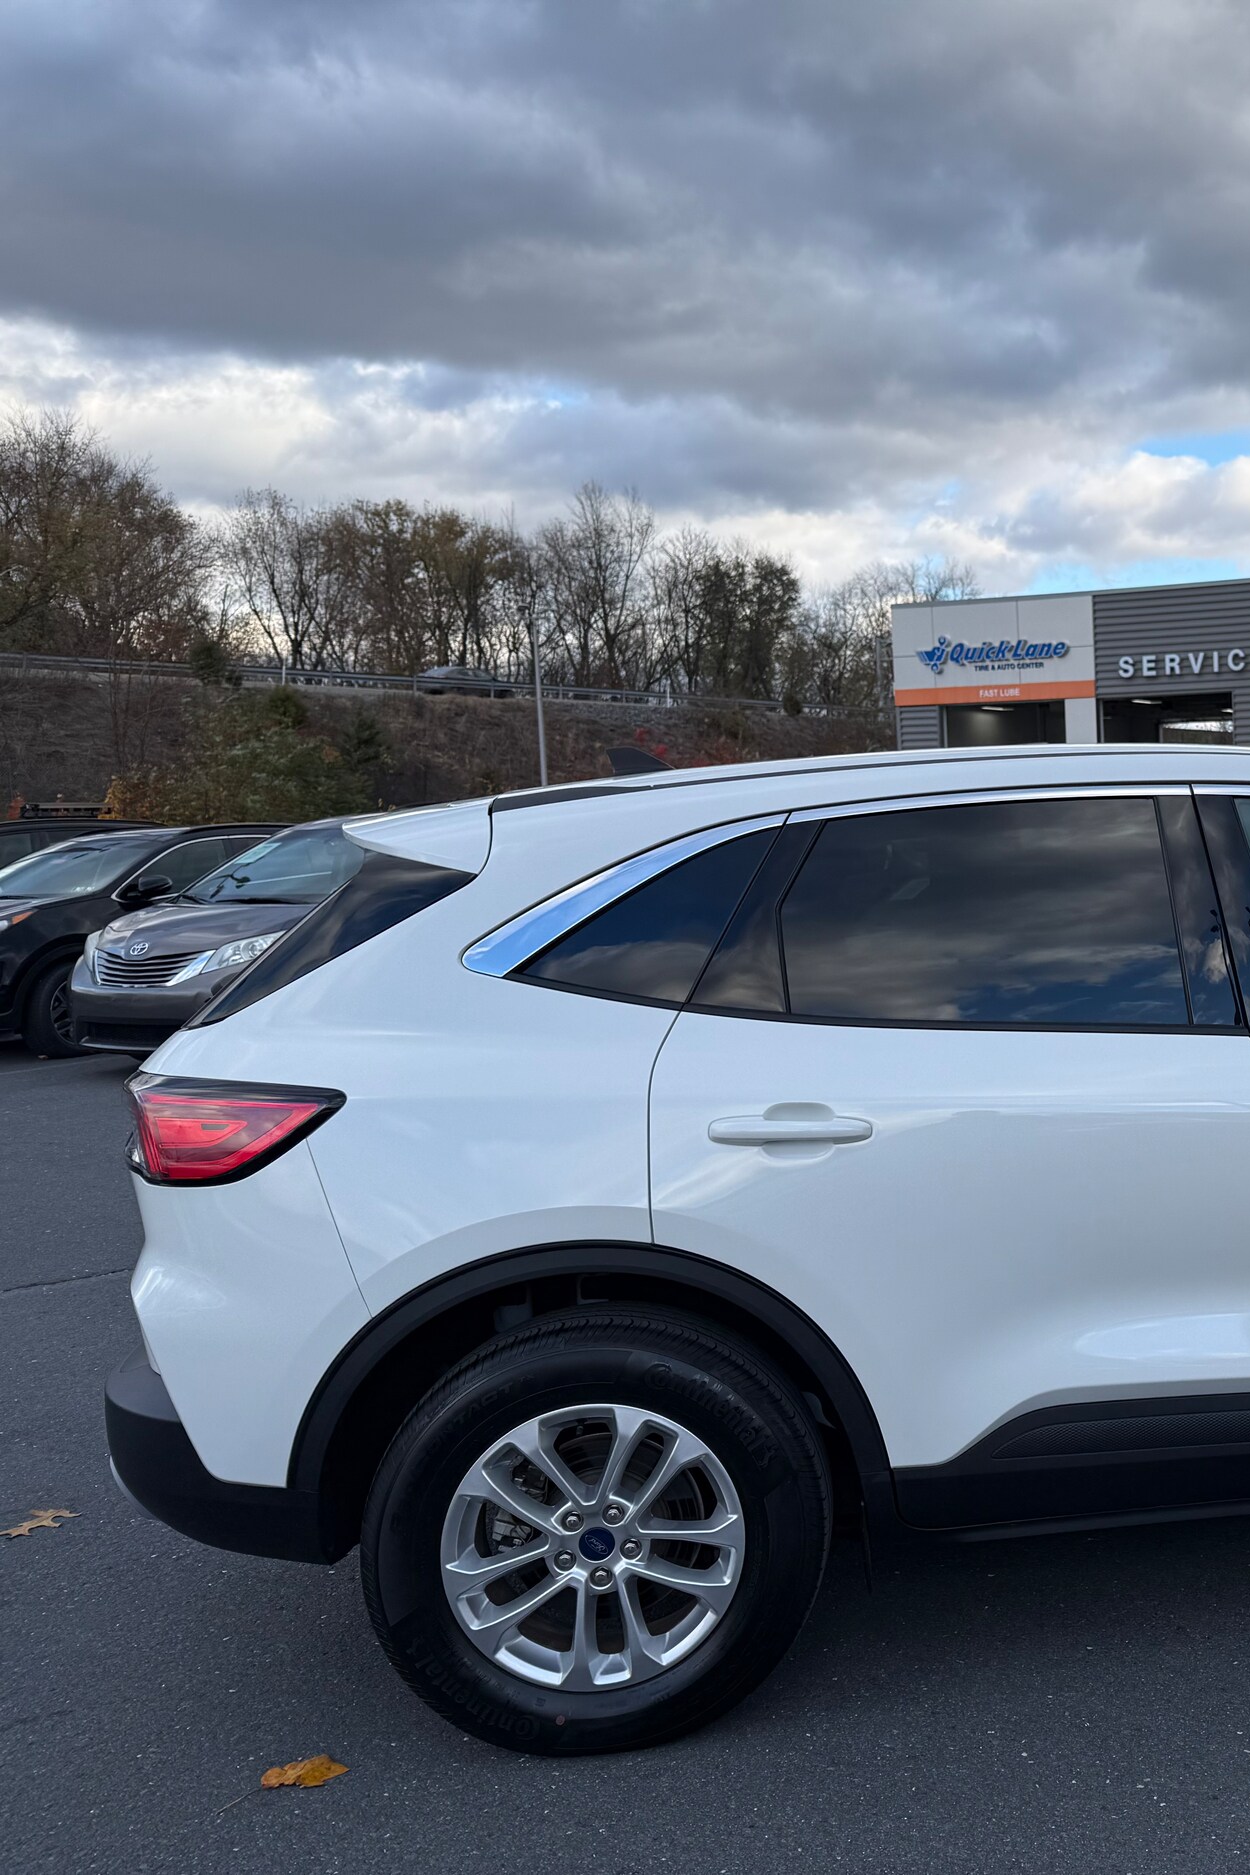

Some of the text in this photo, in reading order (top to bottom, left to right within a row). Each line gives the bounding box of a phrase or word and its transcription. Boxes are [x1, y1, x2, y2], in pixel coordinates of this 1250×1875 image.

[974, 664, 989, 672] TIRE
[997, 663, 1015, 671] AUTO
[1016, 661, 1044, 670] CENTER
[979, 687, 1020, 698] FAST LUBE
